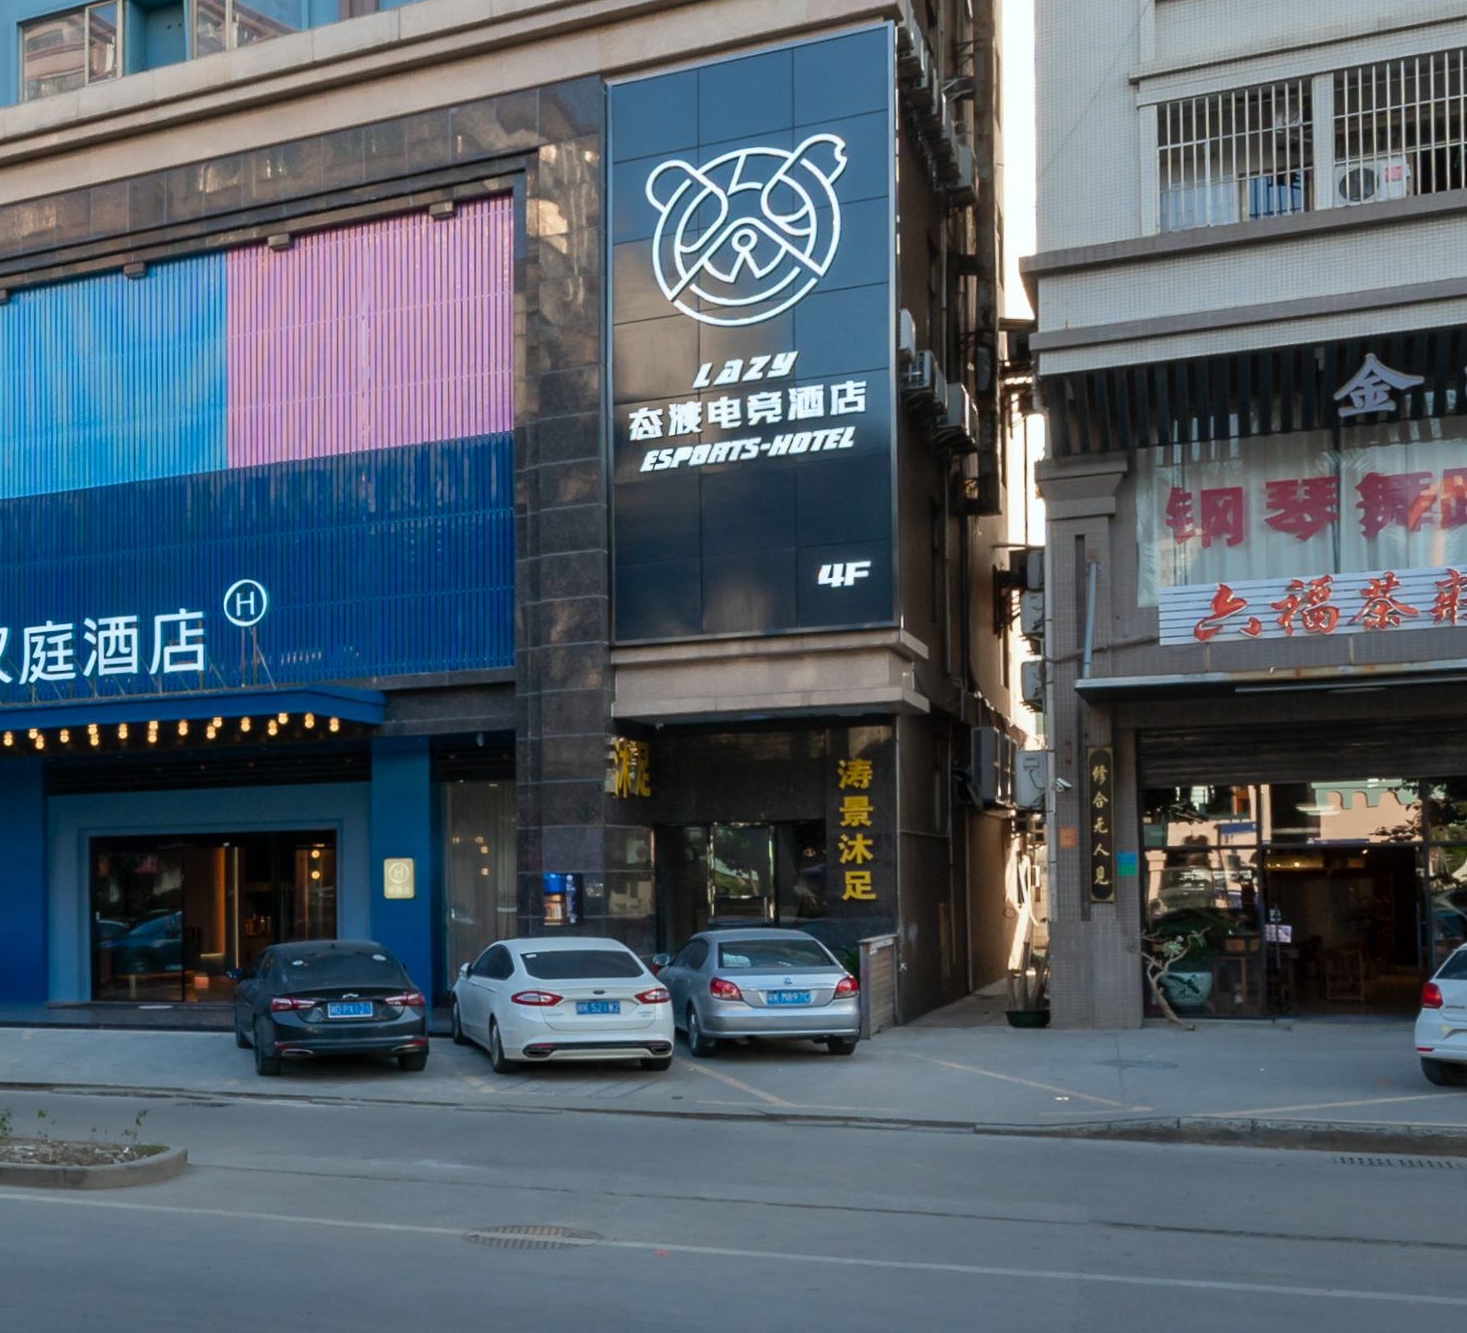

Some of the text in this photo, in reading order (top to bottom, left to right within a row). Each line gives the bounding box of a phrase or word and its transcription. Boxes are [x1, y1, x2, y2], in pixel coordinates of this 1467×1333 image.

[1334, 353, 1425, 417] 金
[640, 426, 856, 472] ESPORTS-HOTEL
[817, 560, 872, 588] 4F
[837, 759, 876, 900] 涛景沐足
